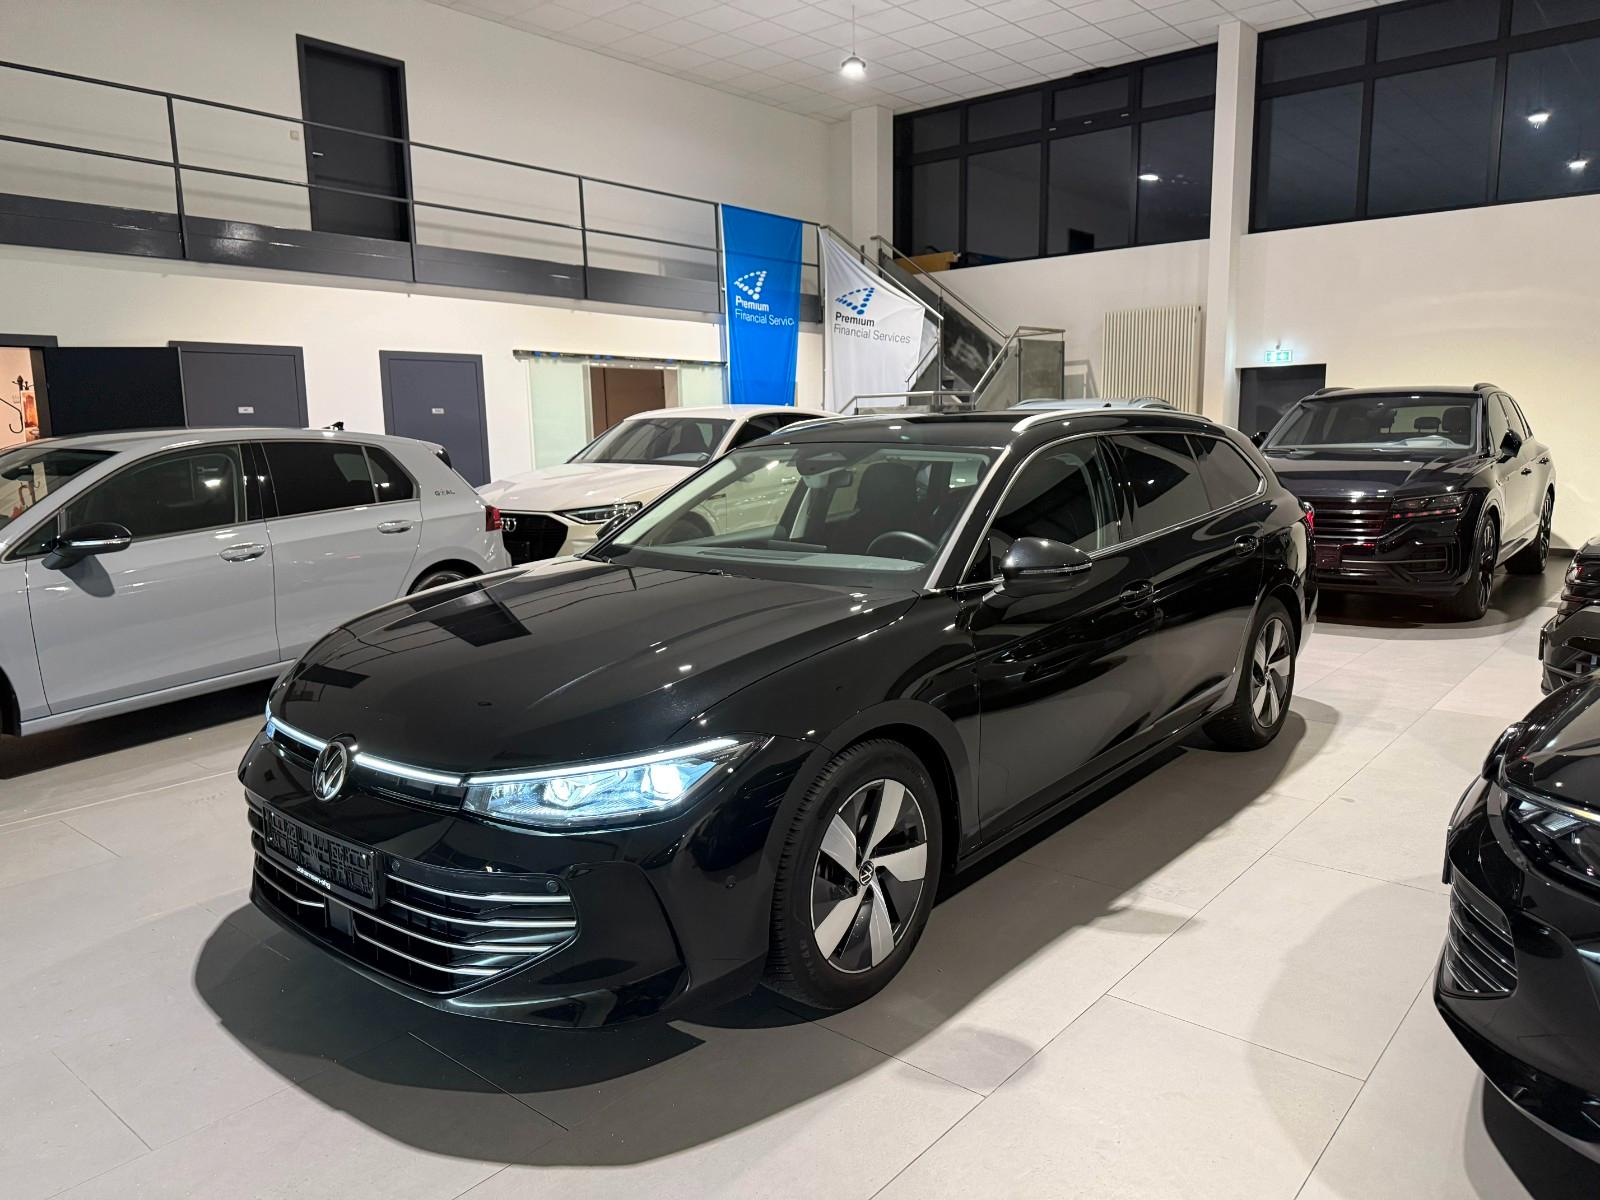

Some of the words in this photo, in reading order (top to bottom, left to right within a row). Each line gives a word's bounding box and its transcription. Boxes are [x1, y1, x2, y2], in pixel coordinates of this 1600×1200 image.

[735, 295, 770, 312] Premium
[735, 308, 767, 324] Financial
[835, 311, 875, 327] Premium
[833, 323, 871, 339] Financial
[872, 329, 912, 344] Services
